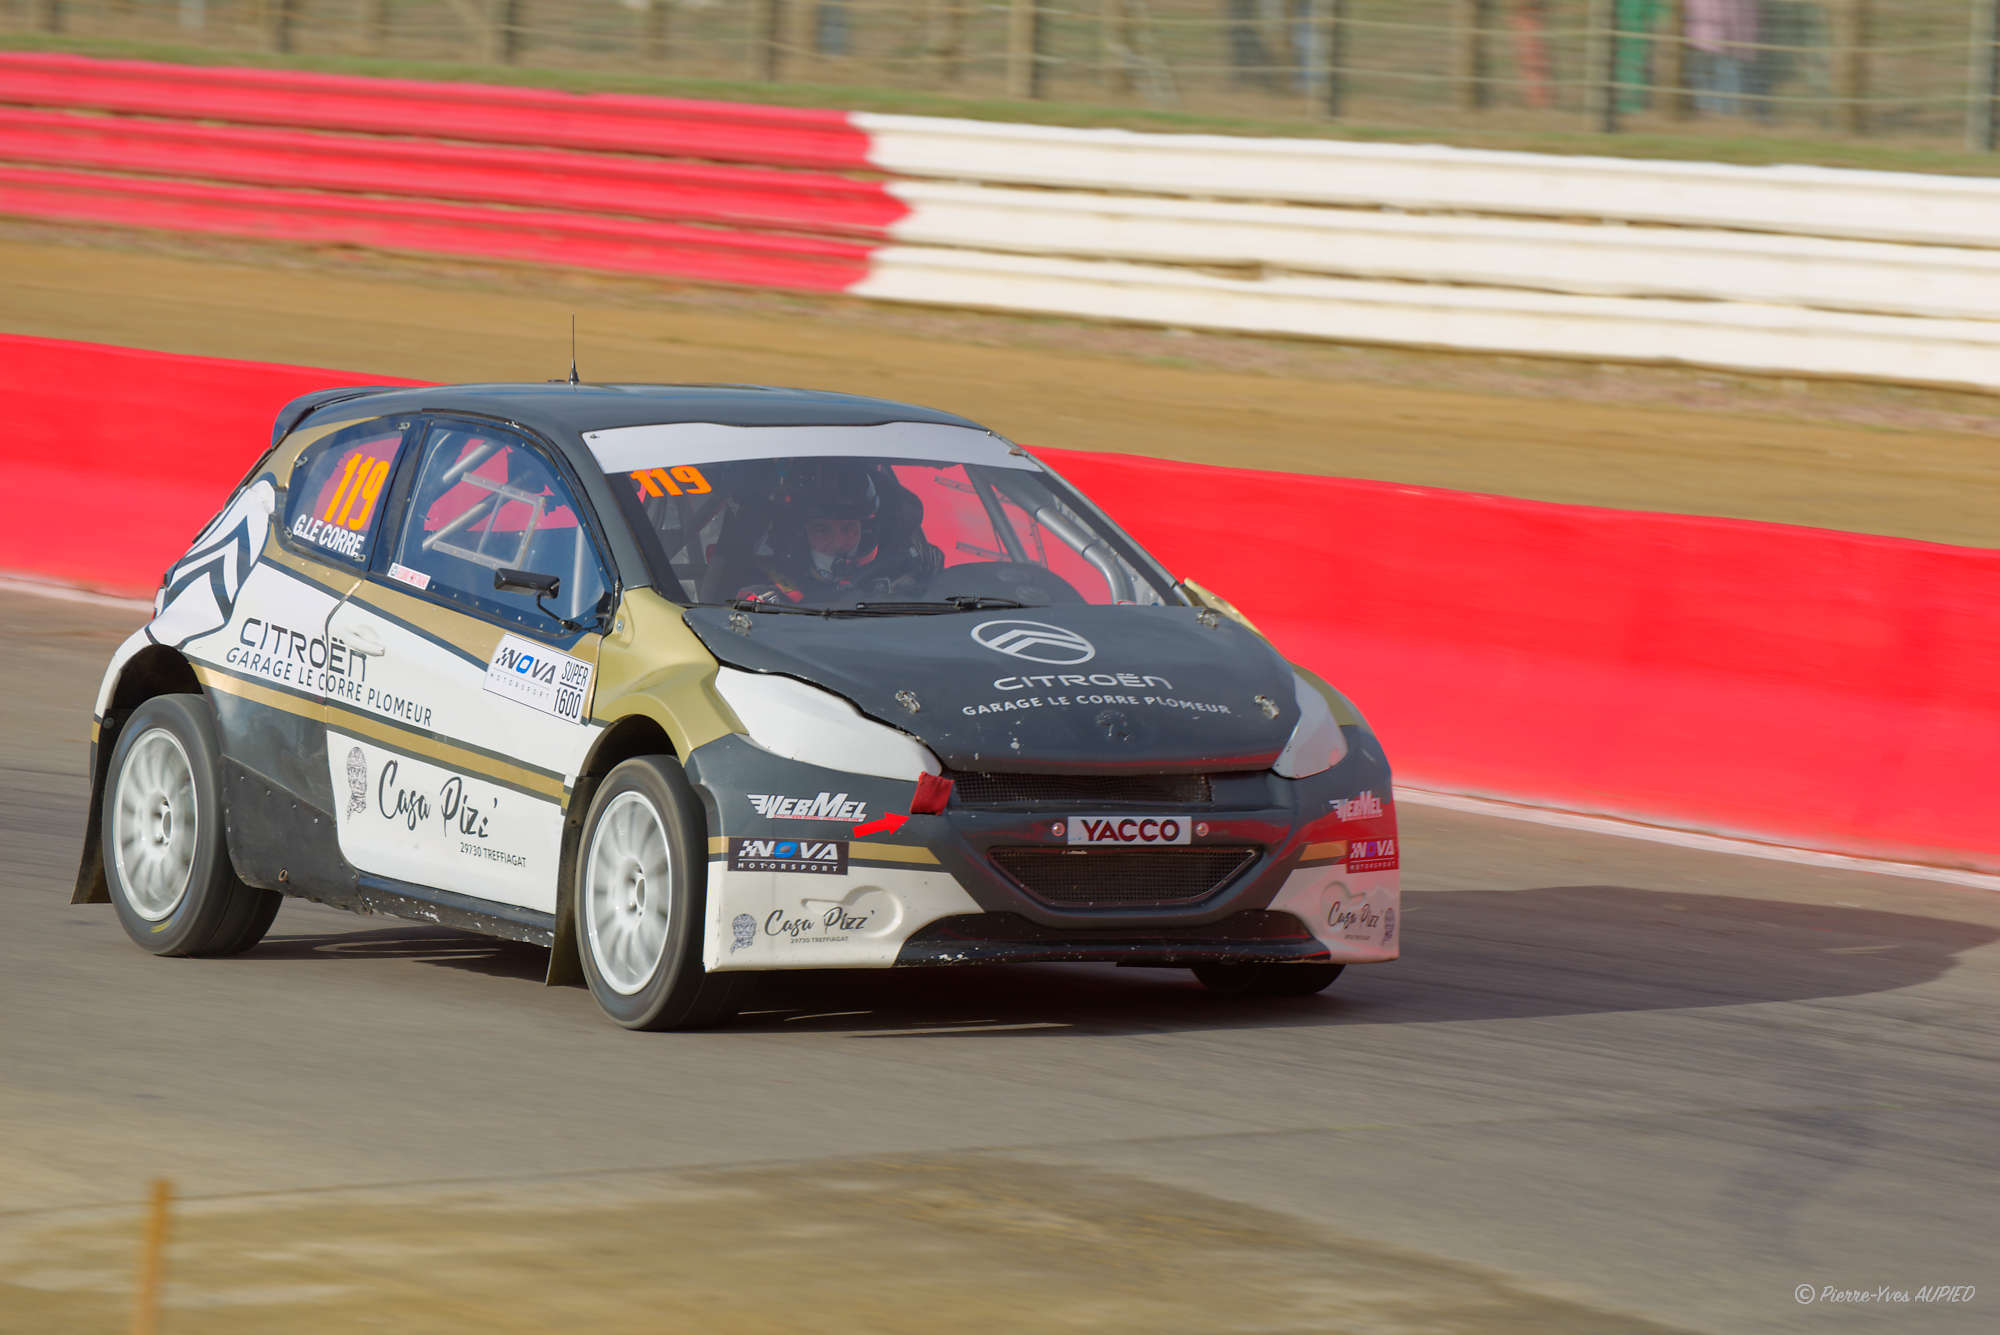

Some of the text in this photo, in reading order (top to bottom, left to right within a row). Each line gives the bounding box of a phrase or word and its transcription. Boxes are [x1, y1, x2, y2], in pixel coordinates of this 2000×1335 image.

[323, 453, 390, 530] 119
[630, 466, 712, 498] 119
[293, 514, 365, 557] G.LE CORRE
[499, 648, 556, 685] NOVA
[562, 661, 589, 687] SUPER
[226, 647, 432, 726] GARAGE LE CORRE PLOMEUR
[554, 688, 581, 719] 1600
[962, 695, 1231, 716] GARAGE LE CORRE PLOMEUR
[378, 759, 432, 831] Casa
[1081, 818, 1180, 842] YACCO
[460, 842, 527, 868] 29730 TREFFIAGAT
[739, 840, 838, 860] NOVA
[1350, 840, 1395, 858] NOVA
[737, 863, 839, 872] MOTORSPORT
[764, 909, 815, 937] Casa
